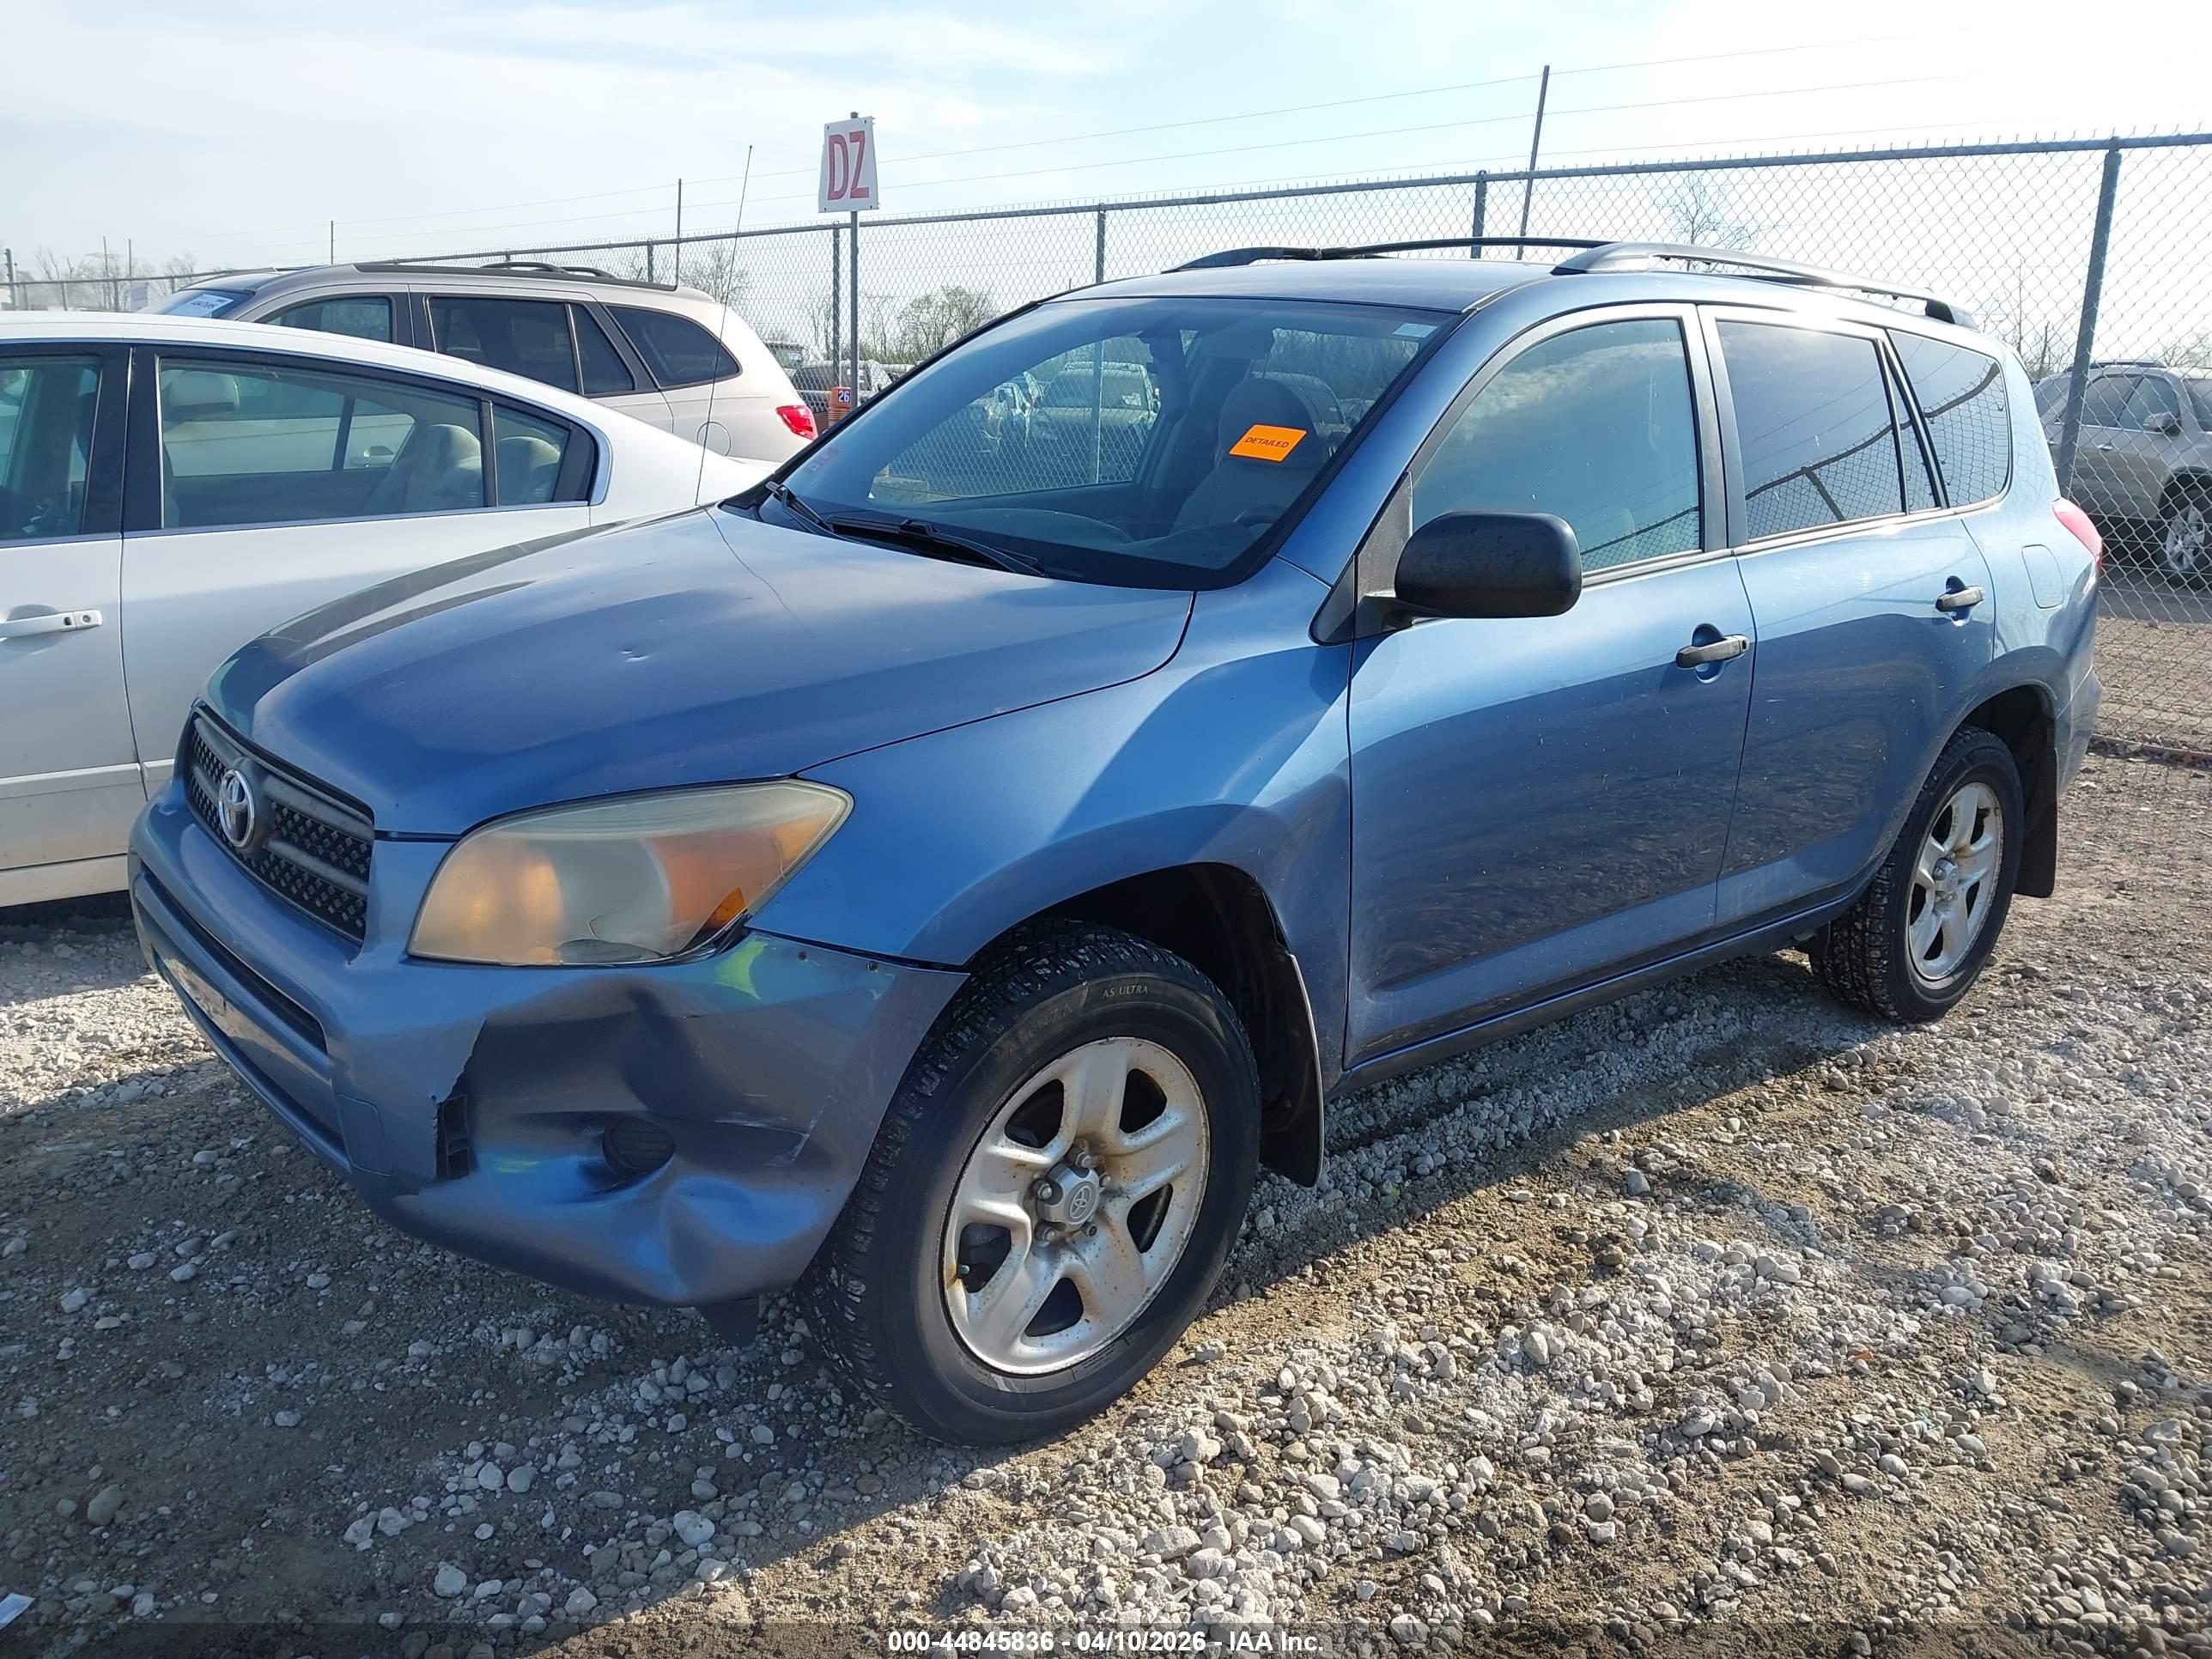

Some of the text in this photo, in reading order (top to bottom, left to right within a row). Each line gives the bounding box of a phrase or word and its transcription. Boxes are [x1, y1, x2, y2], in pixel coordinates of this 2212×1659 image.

[827, 131, 870, 201] DZ
[838, 390, 850, 403] 26
[1243, 436, 1290, 448] DETAILED
[1103, 988, 1115, 999] AS
[1119, 985, 1148, 996] ULTRA
